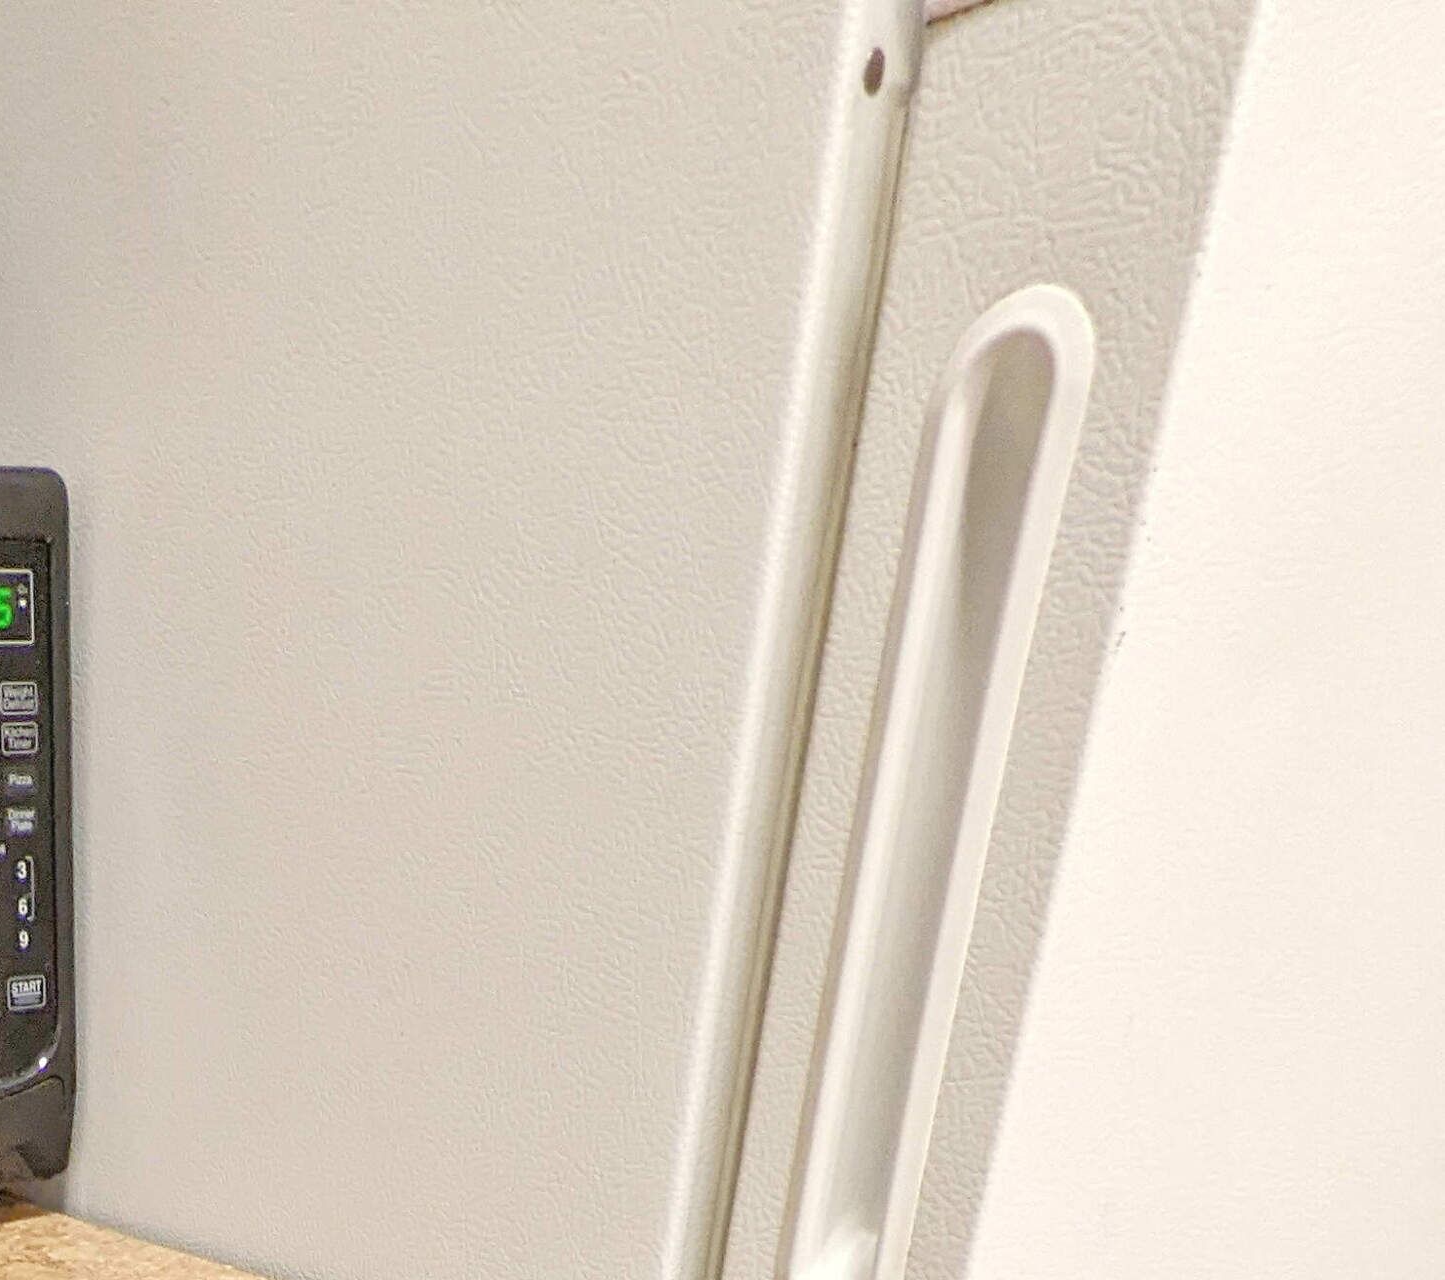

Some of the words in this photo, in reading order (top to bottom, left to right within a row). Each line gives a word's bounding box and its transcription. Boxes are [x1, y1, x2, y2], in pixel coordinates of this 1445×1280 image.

[17, 861, 27, 879] 3
[18, 898, 28, 915] 6
[19, 930, 29, 948] 9
[11, 980, 42, 994] START
